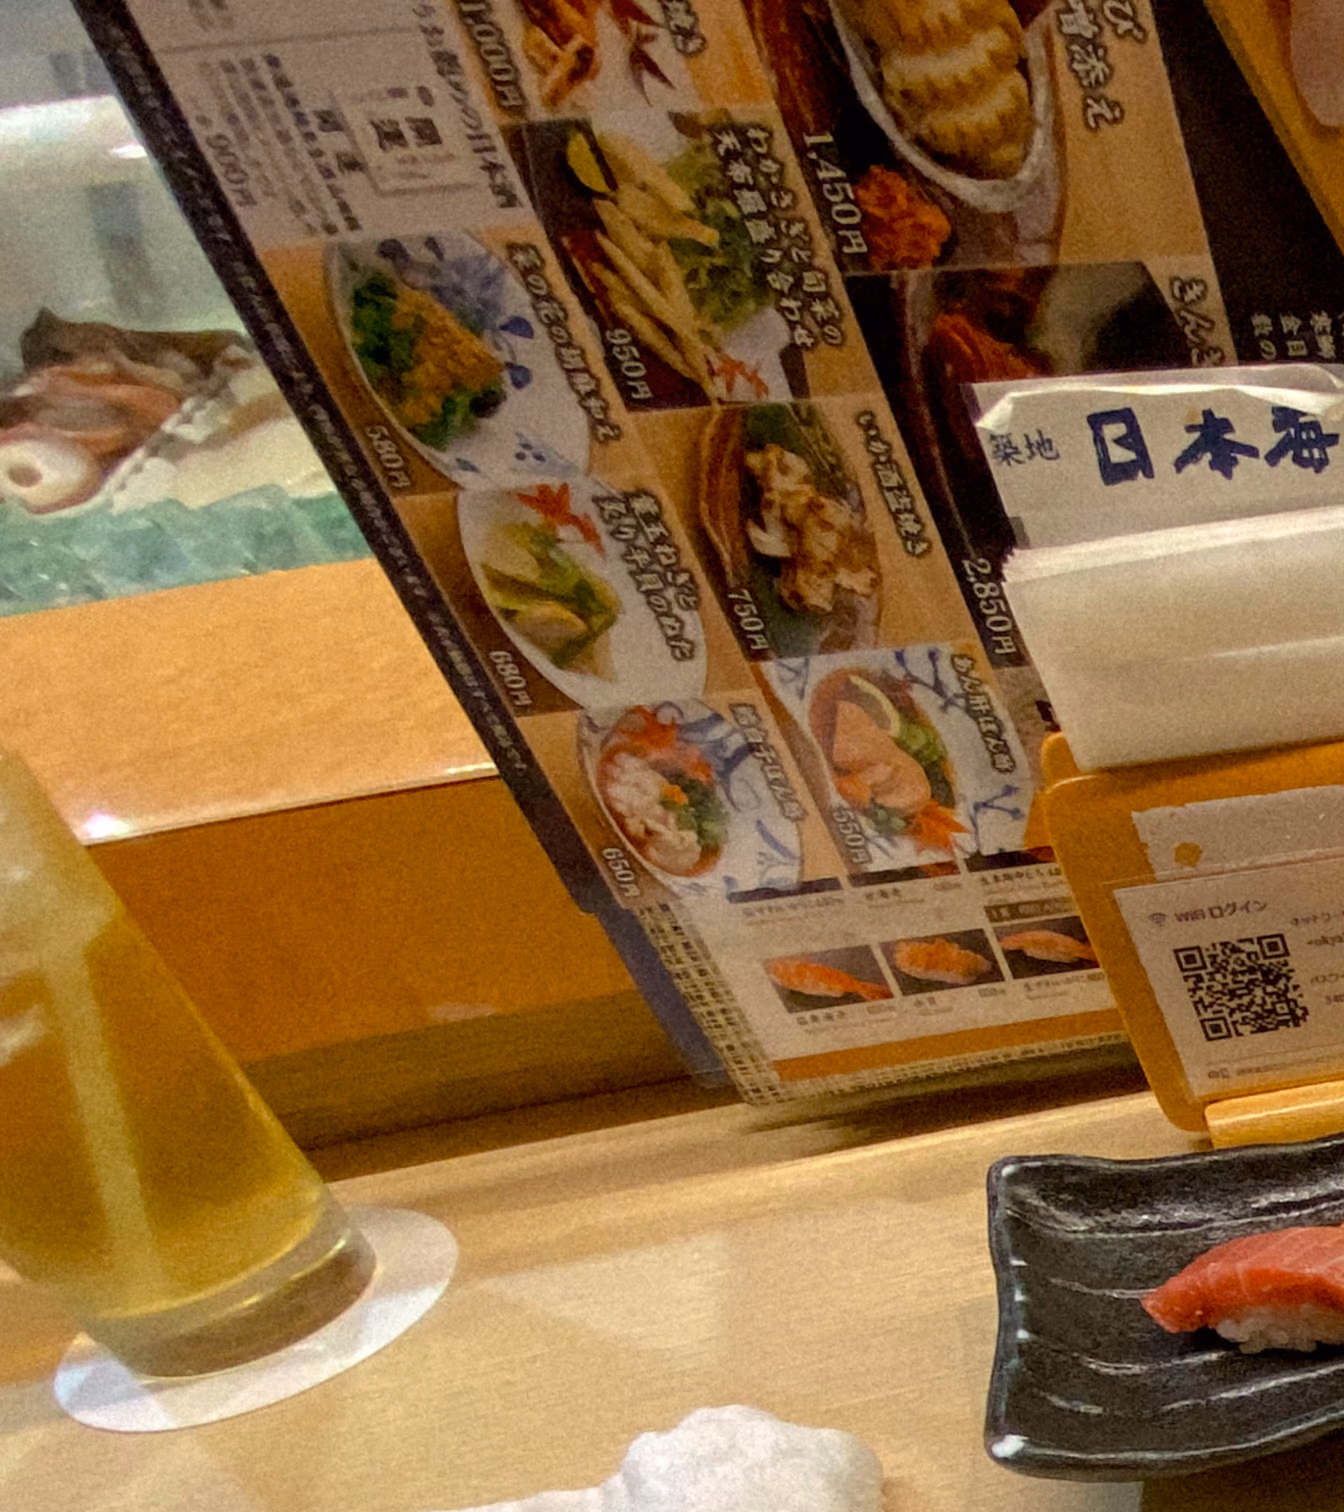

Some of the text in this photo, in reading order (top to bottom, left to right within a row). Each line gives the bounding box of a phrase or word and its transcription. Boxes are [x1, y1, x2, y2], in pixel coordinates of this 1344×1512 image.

[803, 130, 871, 257] 1,450円
[605, 329, 655, 402] 950円
[365, 424, 411, 490] 580円
[990, 406, 1339, 486] 築地 日本海
[728, 589, 770, 653] 750円
[961, 557, 1017, 655] 2,850円
[491, 649, 532, 707] 680円
[833, 805, 871, 867] 550円
[601, 846, 641, 900] 650円
[1209, 900, 1268, 920] ログイン
